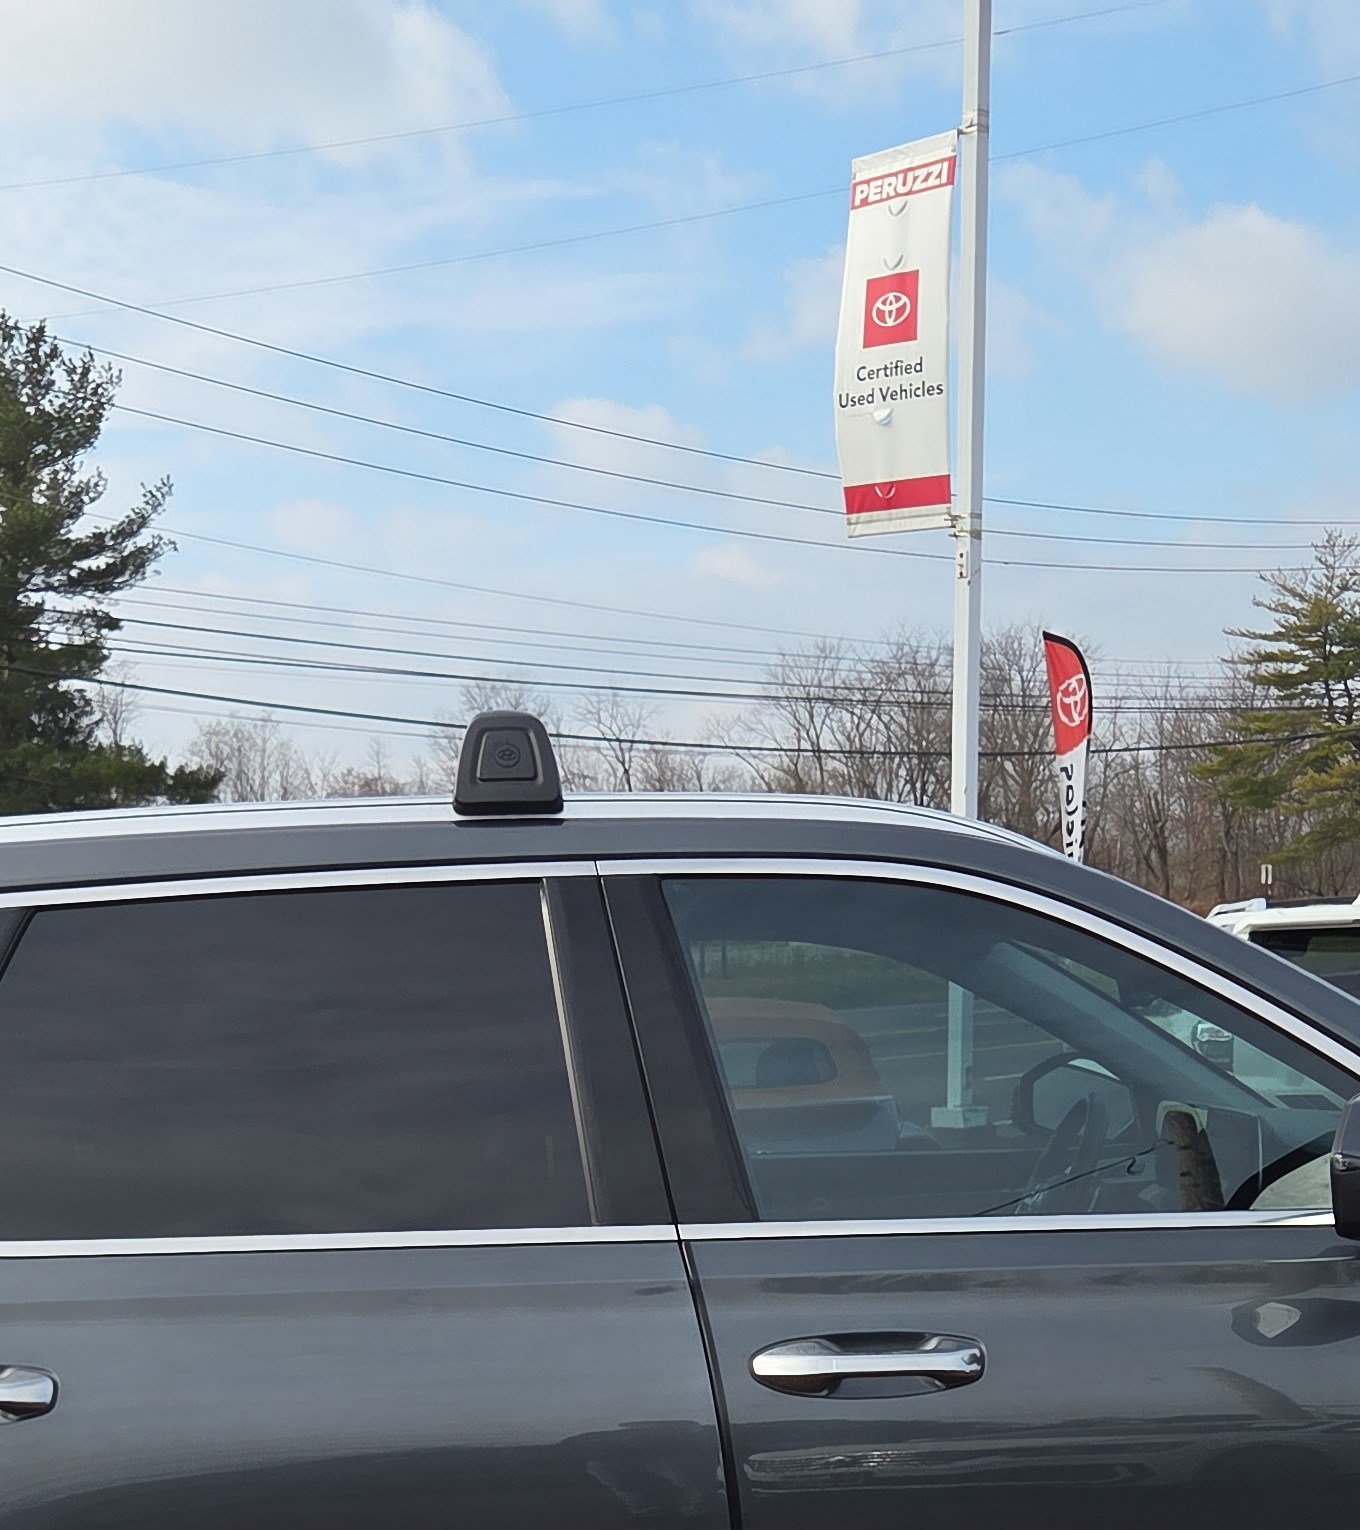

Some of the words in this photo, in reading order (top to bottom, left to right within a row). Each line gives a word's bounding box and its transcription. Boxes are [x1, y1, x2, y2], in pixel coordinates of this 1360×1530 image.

[853, 160, 949, 207] PERUZZI
[856, 356, 923, 381] Certified
[838, 387, 874, 408] Used
[879, 380, 944, 402] Vehicles
